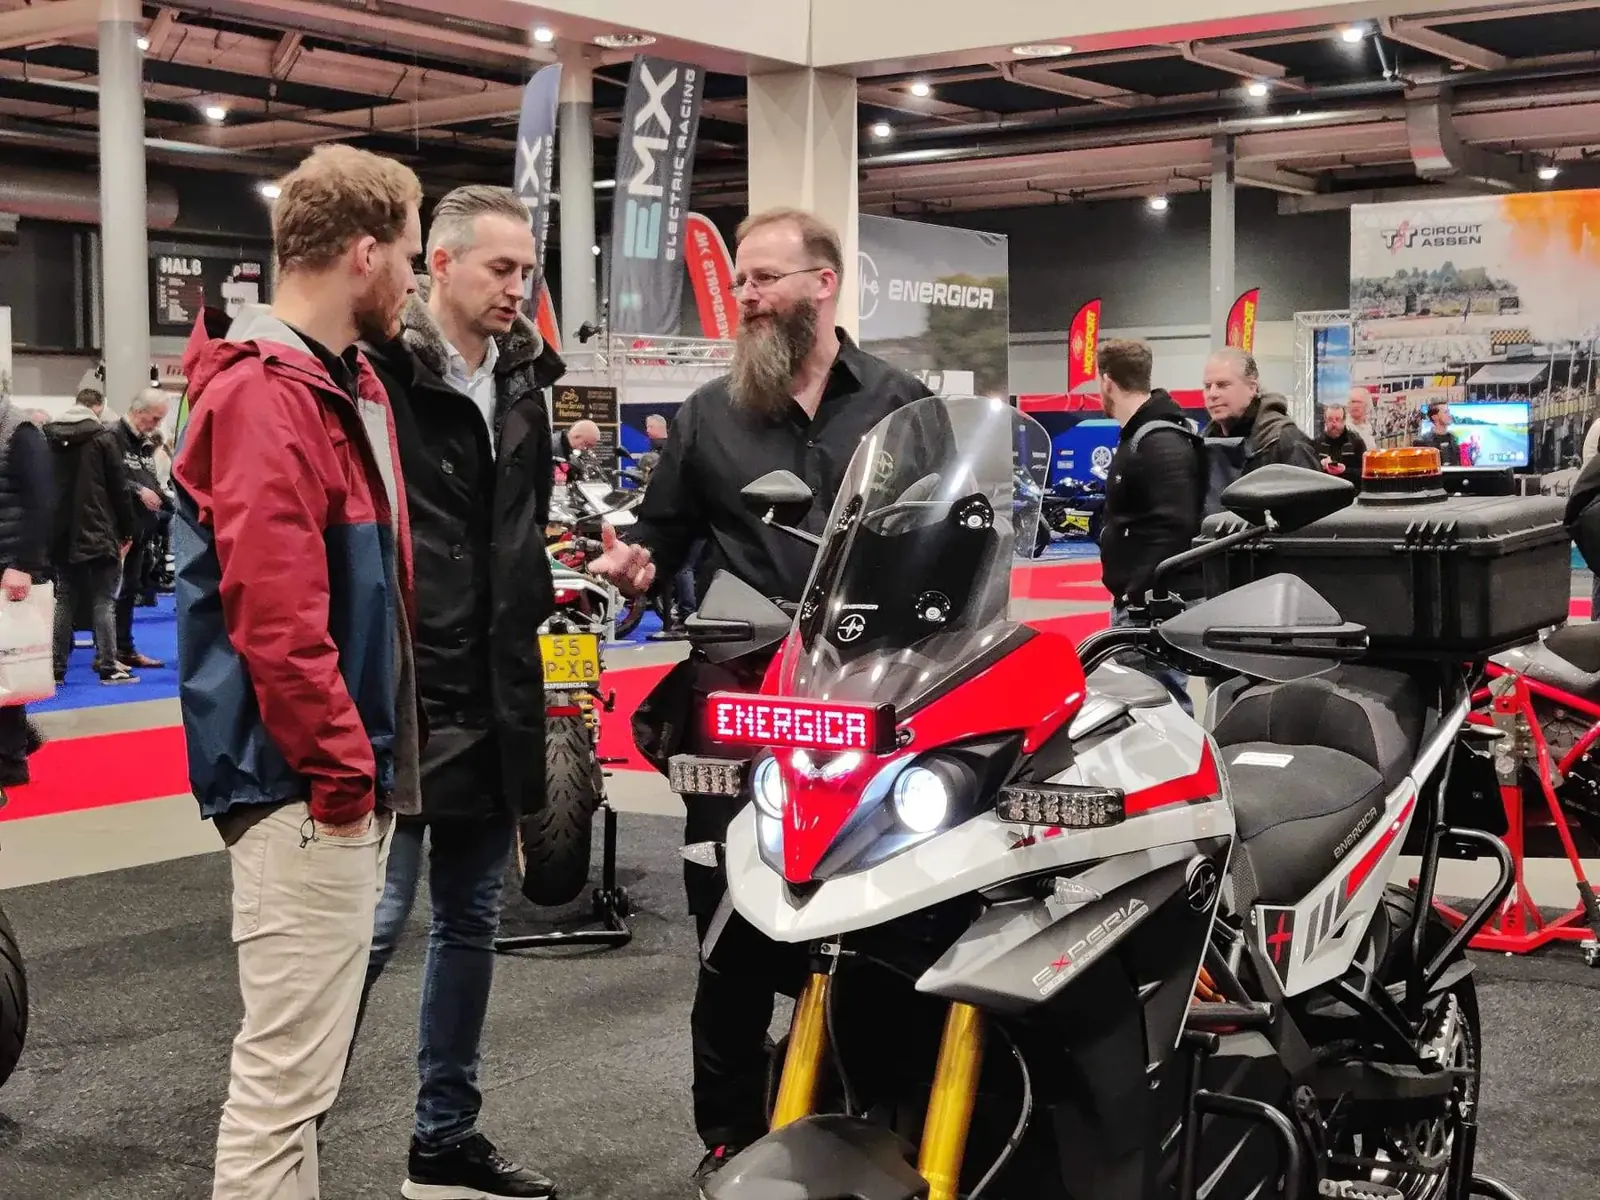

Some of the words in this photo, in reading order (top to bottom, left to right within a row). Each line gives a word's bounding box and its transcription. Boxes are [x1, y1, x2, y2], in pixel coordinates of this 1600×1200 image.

[623, 63, 678, 259] EMX
[666, 157, 685, 261] ELECTRIC
[676, 68, 696, 150] RACING
[1421, 224, 1482, 237] CIRCUIT
[1421, 235, 1482, 248] ASSEN
[160, 257, 191, 276] HAL
[553, 638, 581, 657] 55
[546, 659, 595, 680] P-XB
[717, 703, 866, 747] ENERGICA
[1031, 898, 1145, 988] EXPERIA
